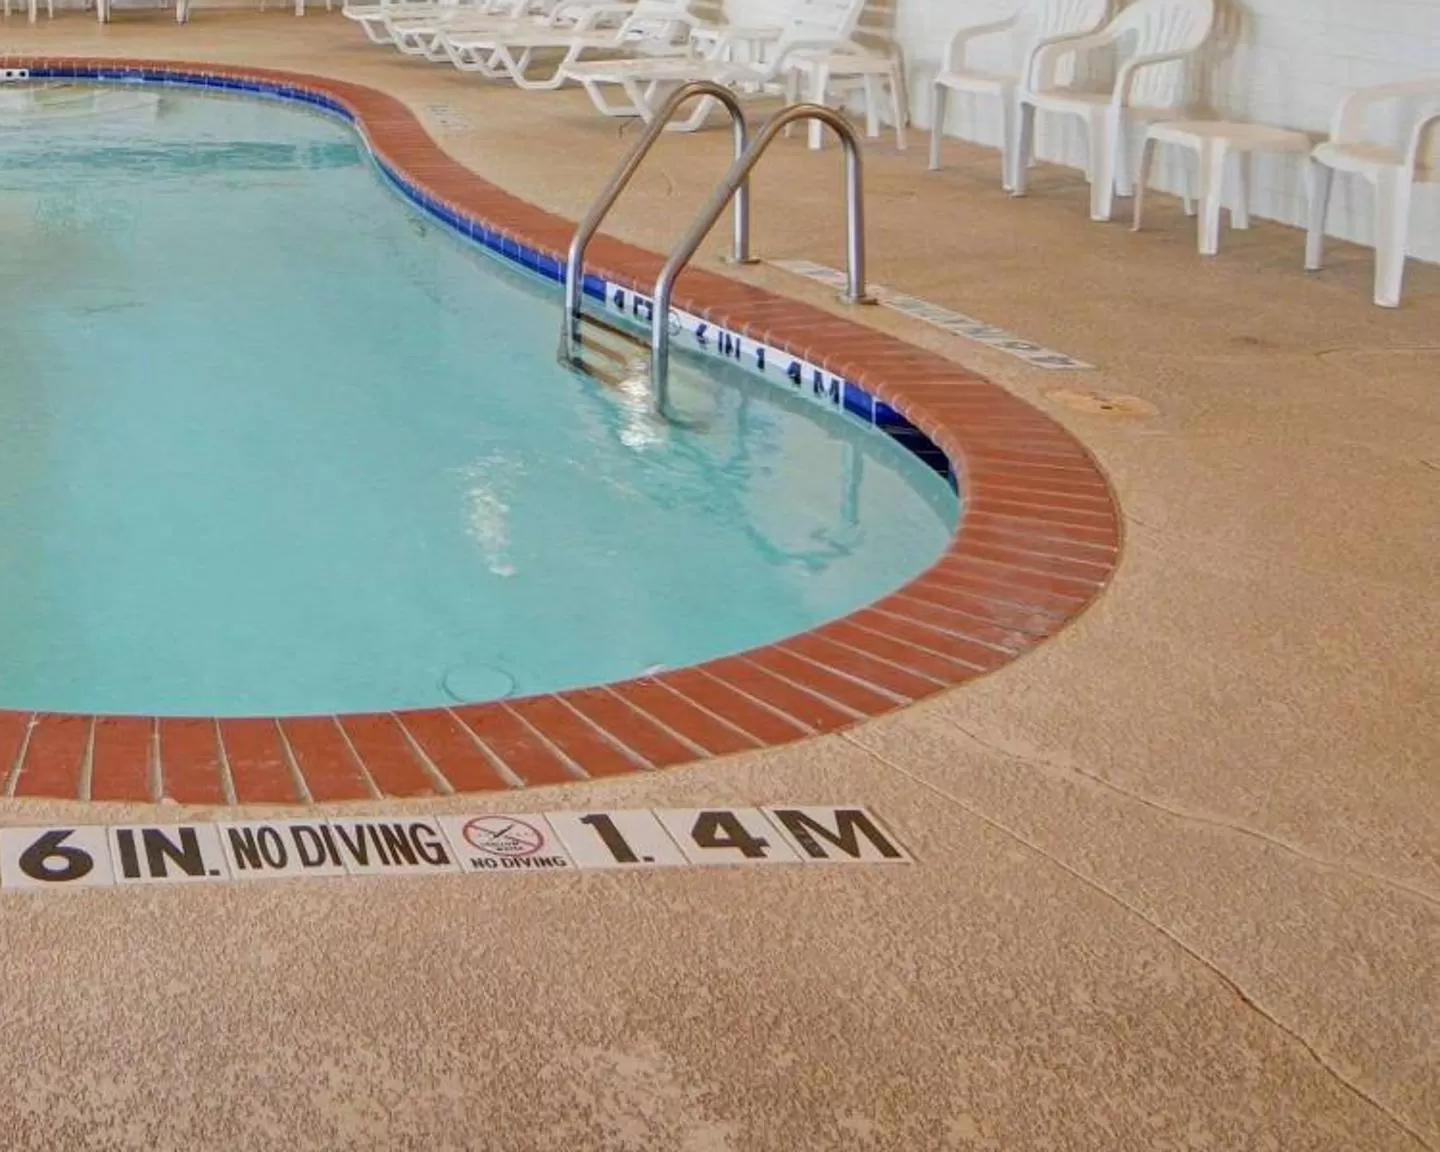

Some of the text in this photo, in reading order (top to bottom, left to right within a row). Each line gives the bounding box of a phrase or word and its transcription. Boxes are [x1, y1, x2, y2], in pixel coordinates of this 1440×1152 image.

[718, 330, 741, 362] IN
[17, 828, 94, 882] 6
[116, 827, 222, 879] IN.
[227, 826, 289, 870] NO
[297, 822, 451, 869] DIVING
[690, 811, 767, 859] 4
[774, 808, 903, 860] M
[469, 855, 568, 869] NO DIVING
